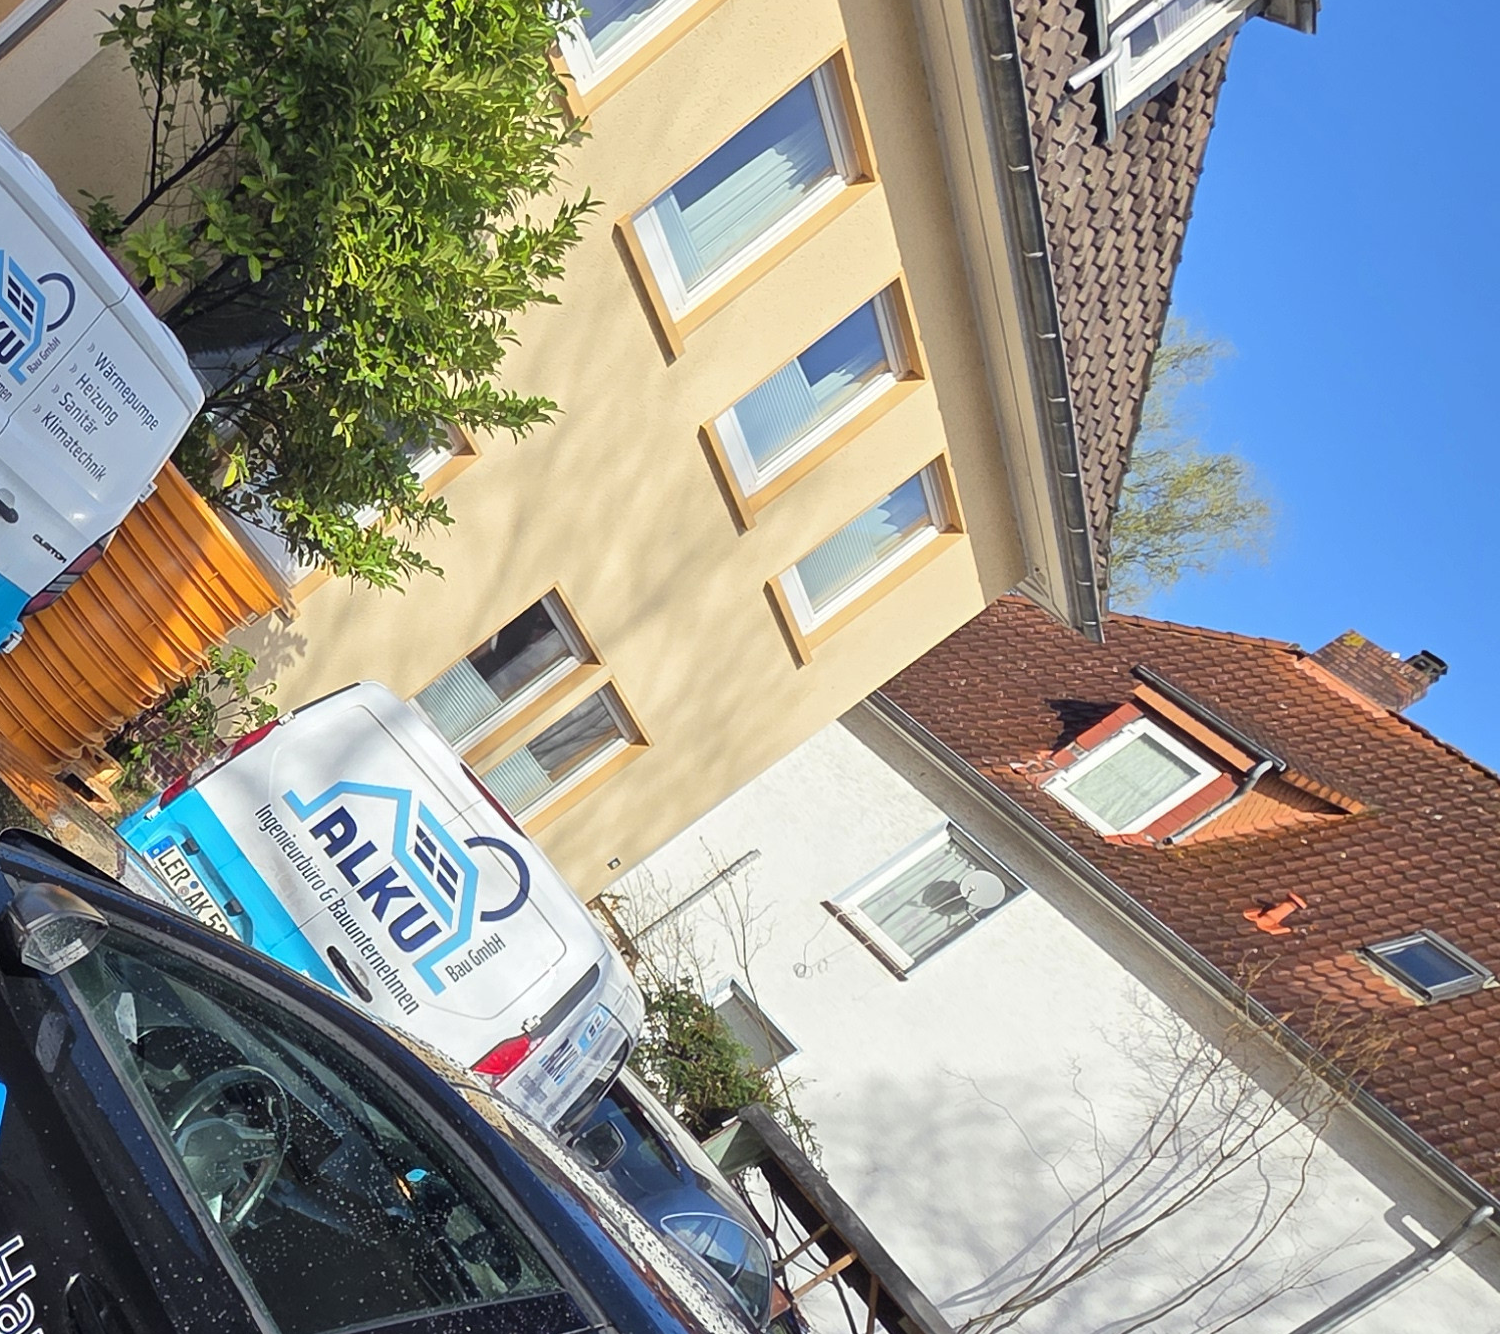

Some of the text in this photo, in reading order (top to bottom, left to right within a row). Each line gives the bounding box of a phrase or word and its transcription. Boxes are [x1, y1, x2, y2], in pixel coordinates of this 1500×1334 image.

[26, 336, 62, 374] Bau GmbH
[58, 392, 99, 436] Sanitär
[76, 373, 119, 426] Heizung
[94, 352, 159, 432] Wärmepumpe
[41, 411, 107, 482] Klimatechnik
[157, 848, 191, 887] LER
[184, 889, 210, 916] AK
[255, 804, 420, 1015] Ingenieurbüro & Bauunternehmen
[309, 805, 442, 953] ALKU
[445, 933, 506, 983] Bau GmbH
